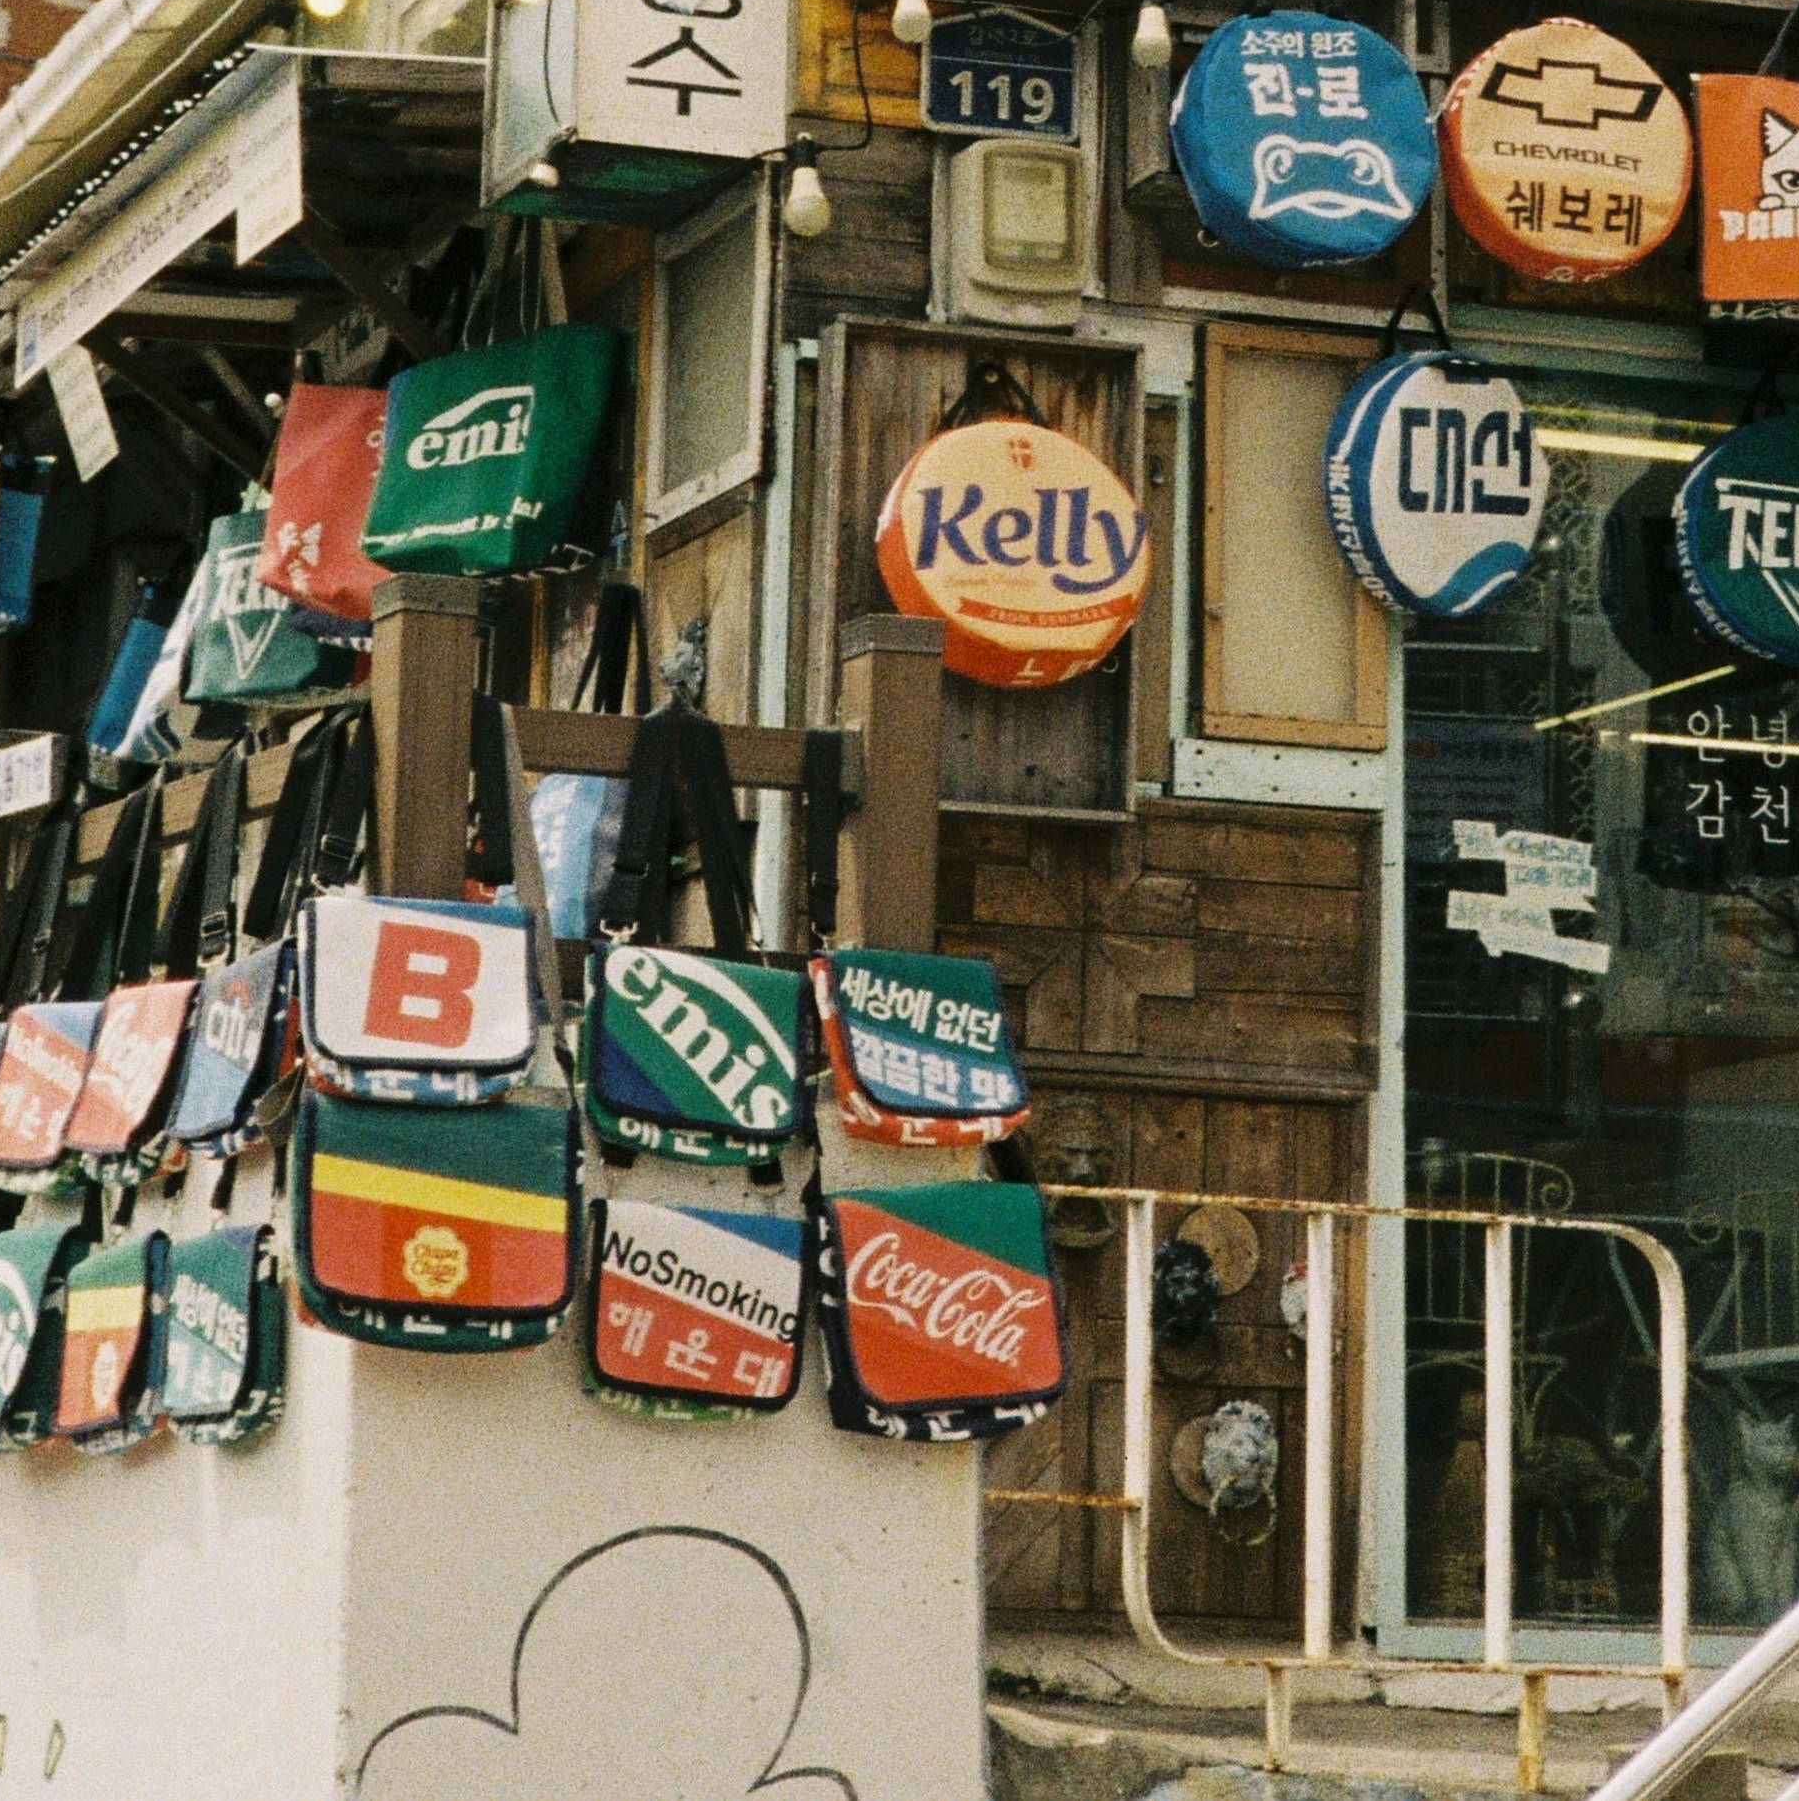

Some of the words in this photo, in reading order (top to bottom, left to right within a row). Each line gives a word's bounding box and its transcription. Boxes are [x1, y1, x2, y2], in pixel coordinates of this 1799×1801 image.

[1240, 30, 1305, 59] 소주의
[1310, 31, 1358, 59] 원조
[949, 70, 1054, 124] 119
[1493, 140, 1643, 173] CHEVROLET
[1505, 179, 1643, 246] 쉐보레
[1397, 406, 1533, 517] 대선
[915, 483, 1148, 595] Kelly
[1687, 704, 1788, 769] 안녕
[1685, 779, 1791, 844] 감천
[363, 920, 481, 1049] B
[839, 966, 934, 1034] 세상에
[933, 998, 1002, 1054] 없던
[604, 945, 791, 1131] emis
[845, 1231, 1047, 1367] Coca-Cola
[606, 1300, 787, 1399] 해운대
